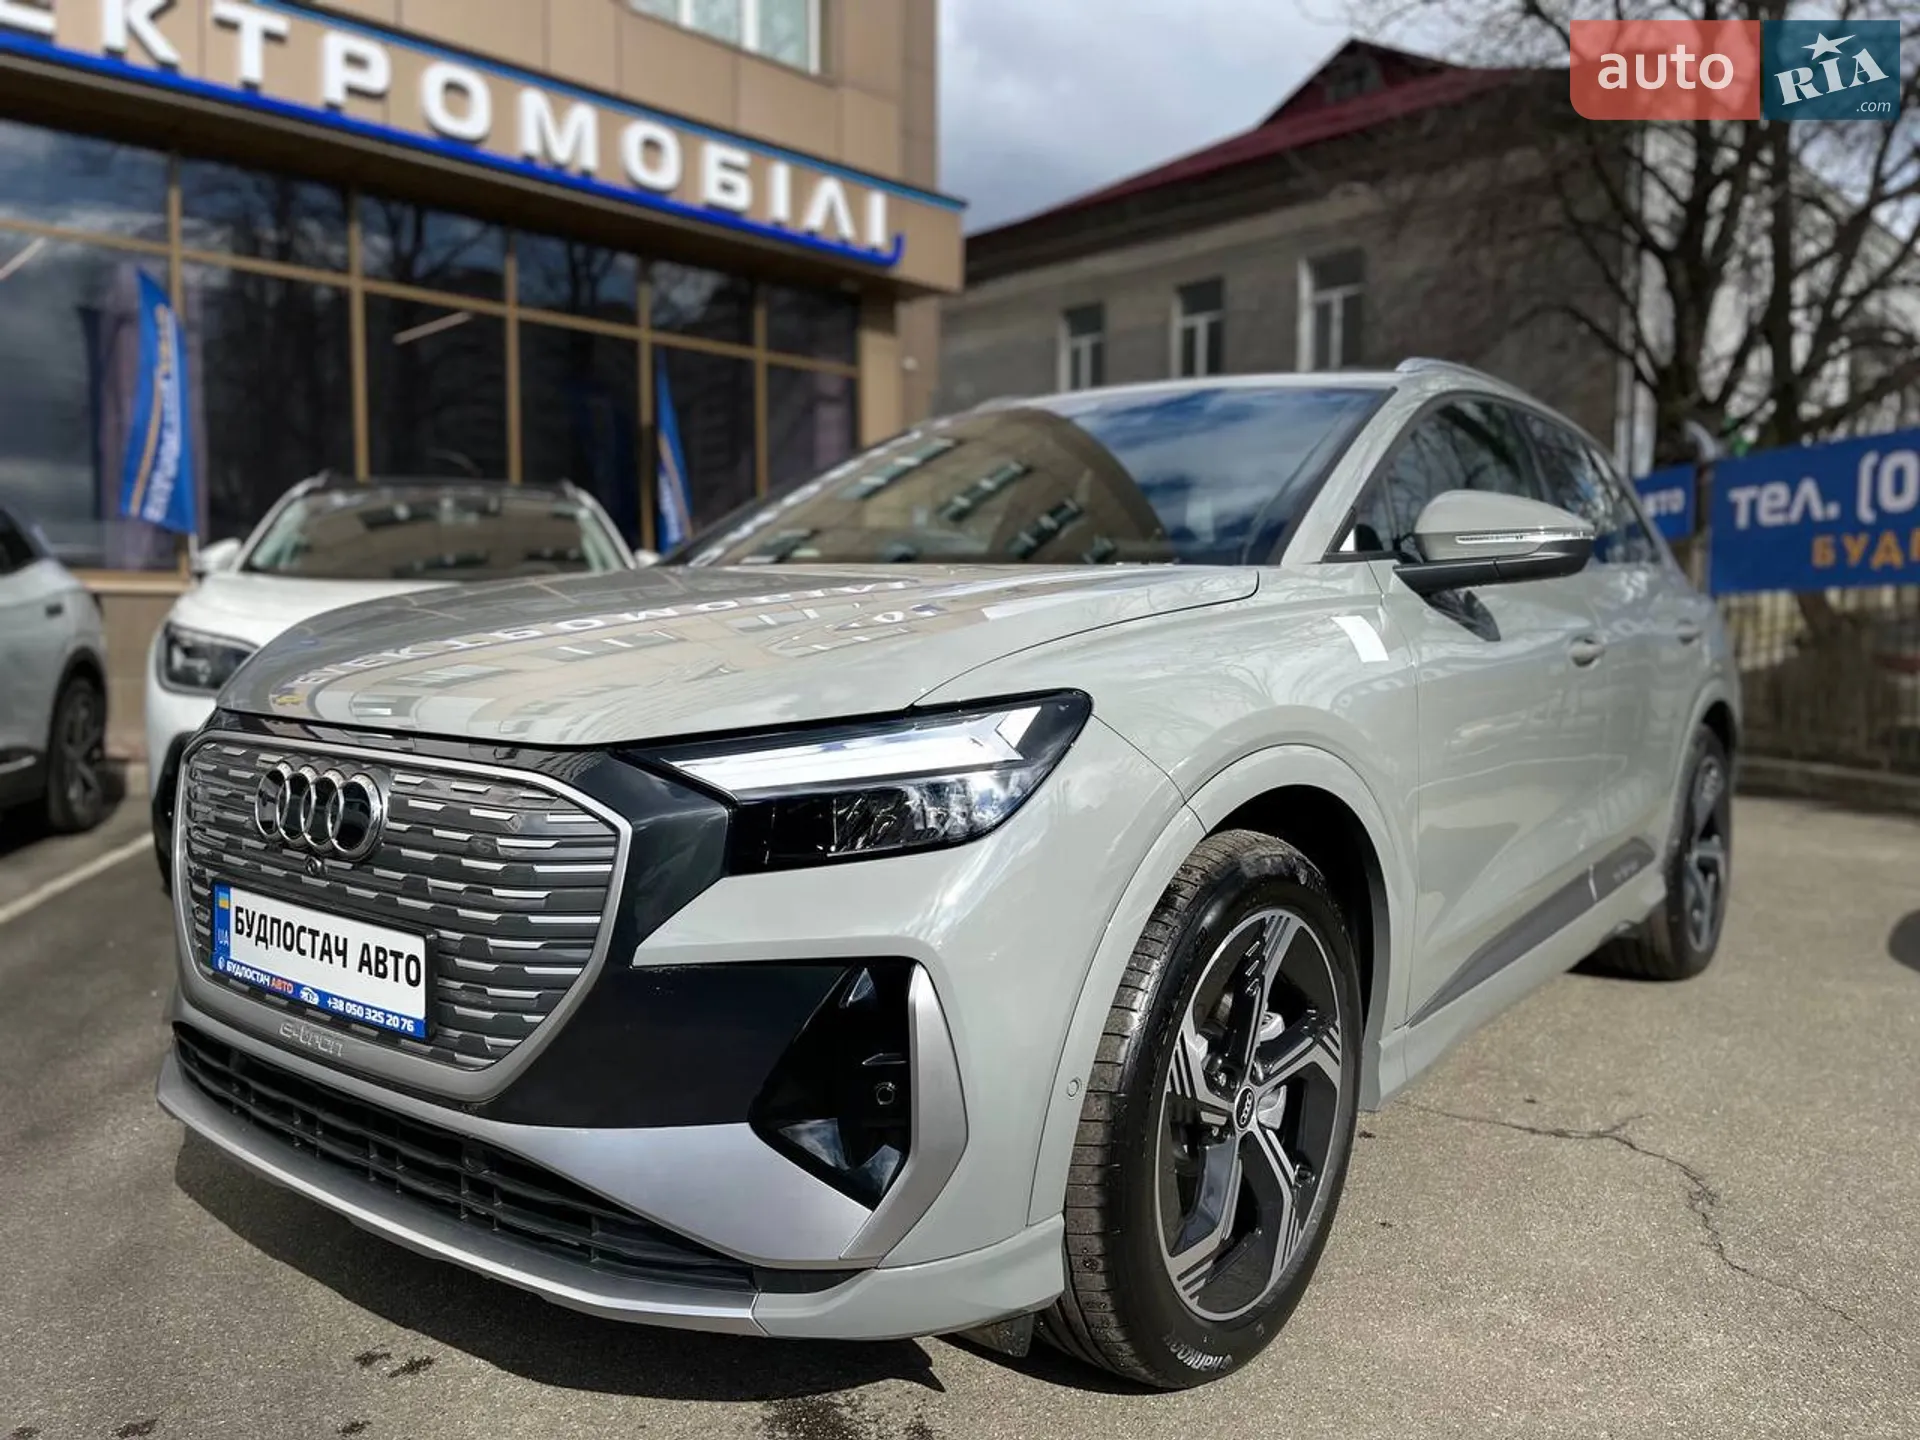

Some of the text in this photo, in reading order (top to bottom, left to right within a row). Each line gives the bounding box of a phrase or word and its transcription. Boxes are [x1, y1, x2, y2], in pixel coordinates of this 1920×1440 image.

[1728, 476, 1841, 530] тел.
[234, 906, 422, 988] БУДПОСТАЧ АВТО
[226, 960, 414, 1032] БУДПОСТАЧ АВТО +38 050 325 20 76
